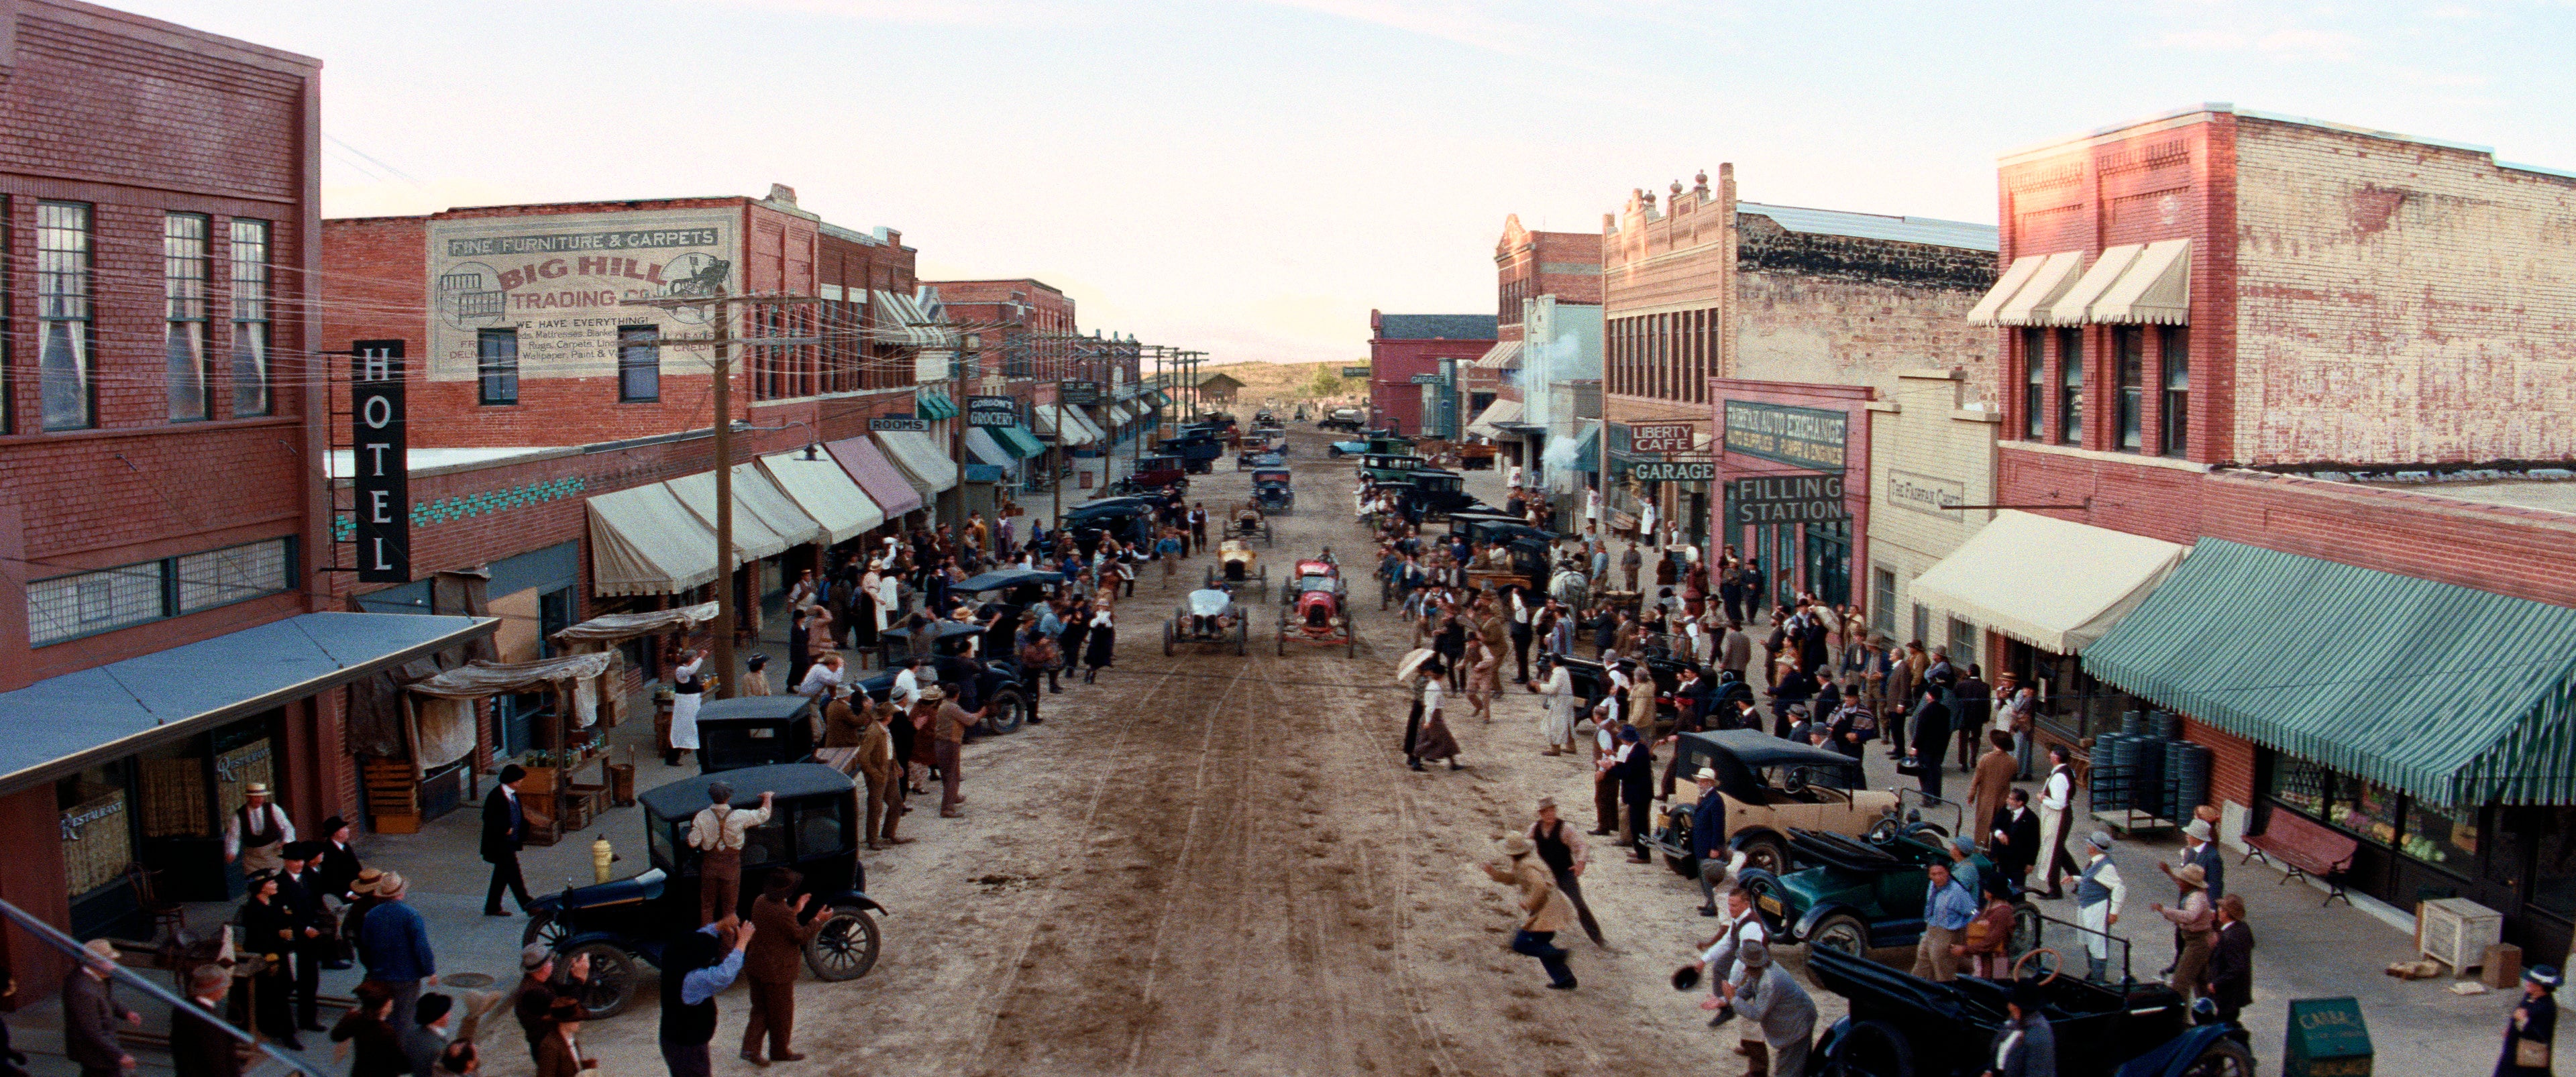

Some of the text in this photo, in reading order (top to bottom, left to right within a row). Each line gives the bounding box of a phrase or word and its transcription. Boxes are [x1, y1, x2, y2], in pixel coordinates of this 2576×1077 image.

[453, 231, 714, 254] FINE FURNITURE & CARPETS
[497, 256, 668, 291] BIG HILL
[511, 289, 616, 309] TRADING
[516, 317, 649, 329] WE HAVE EVERYTHING!
[587, 328, 618, 337] Blanket
[571, 349, 595, 359] Paint
[873, 420, 924, 430] ROOMS
[970, 411, 1014, 426] GROCERY
[1727, 406, 1844, 445] FAIRFAX AUTO EXCHANGE
[1633, 426, 1690, 439] LIBERTY
[1635, 438, 1688, 451] CAFE
[363, 347, 392, 571] HOTEL
[1636, 464, 1714, 479] GARAGE
[1740, 477, 1841, 500] FILLING
[1740, 501, 1841, 522] STATION
